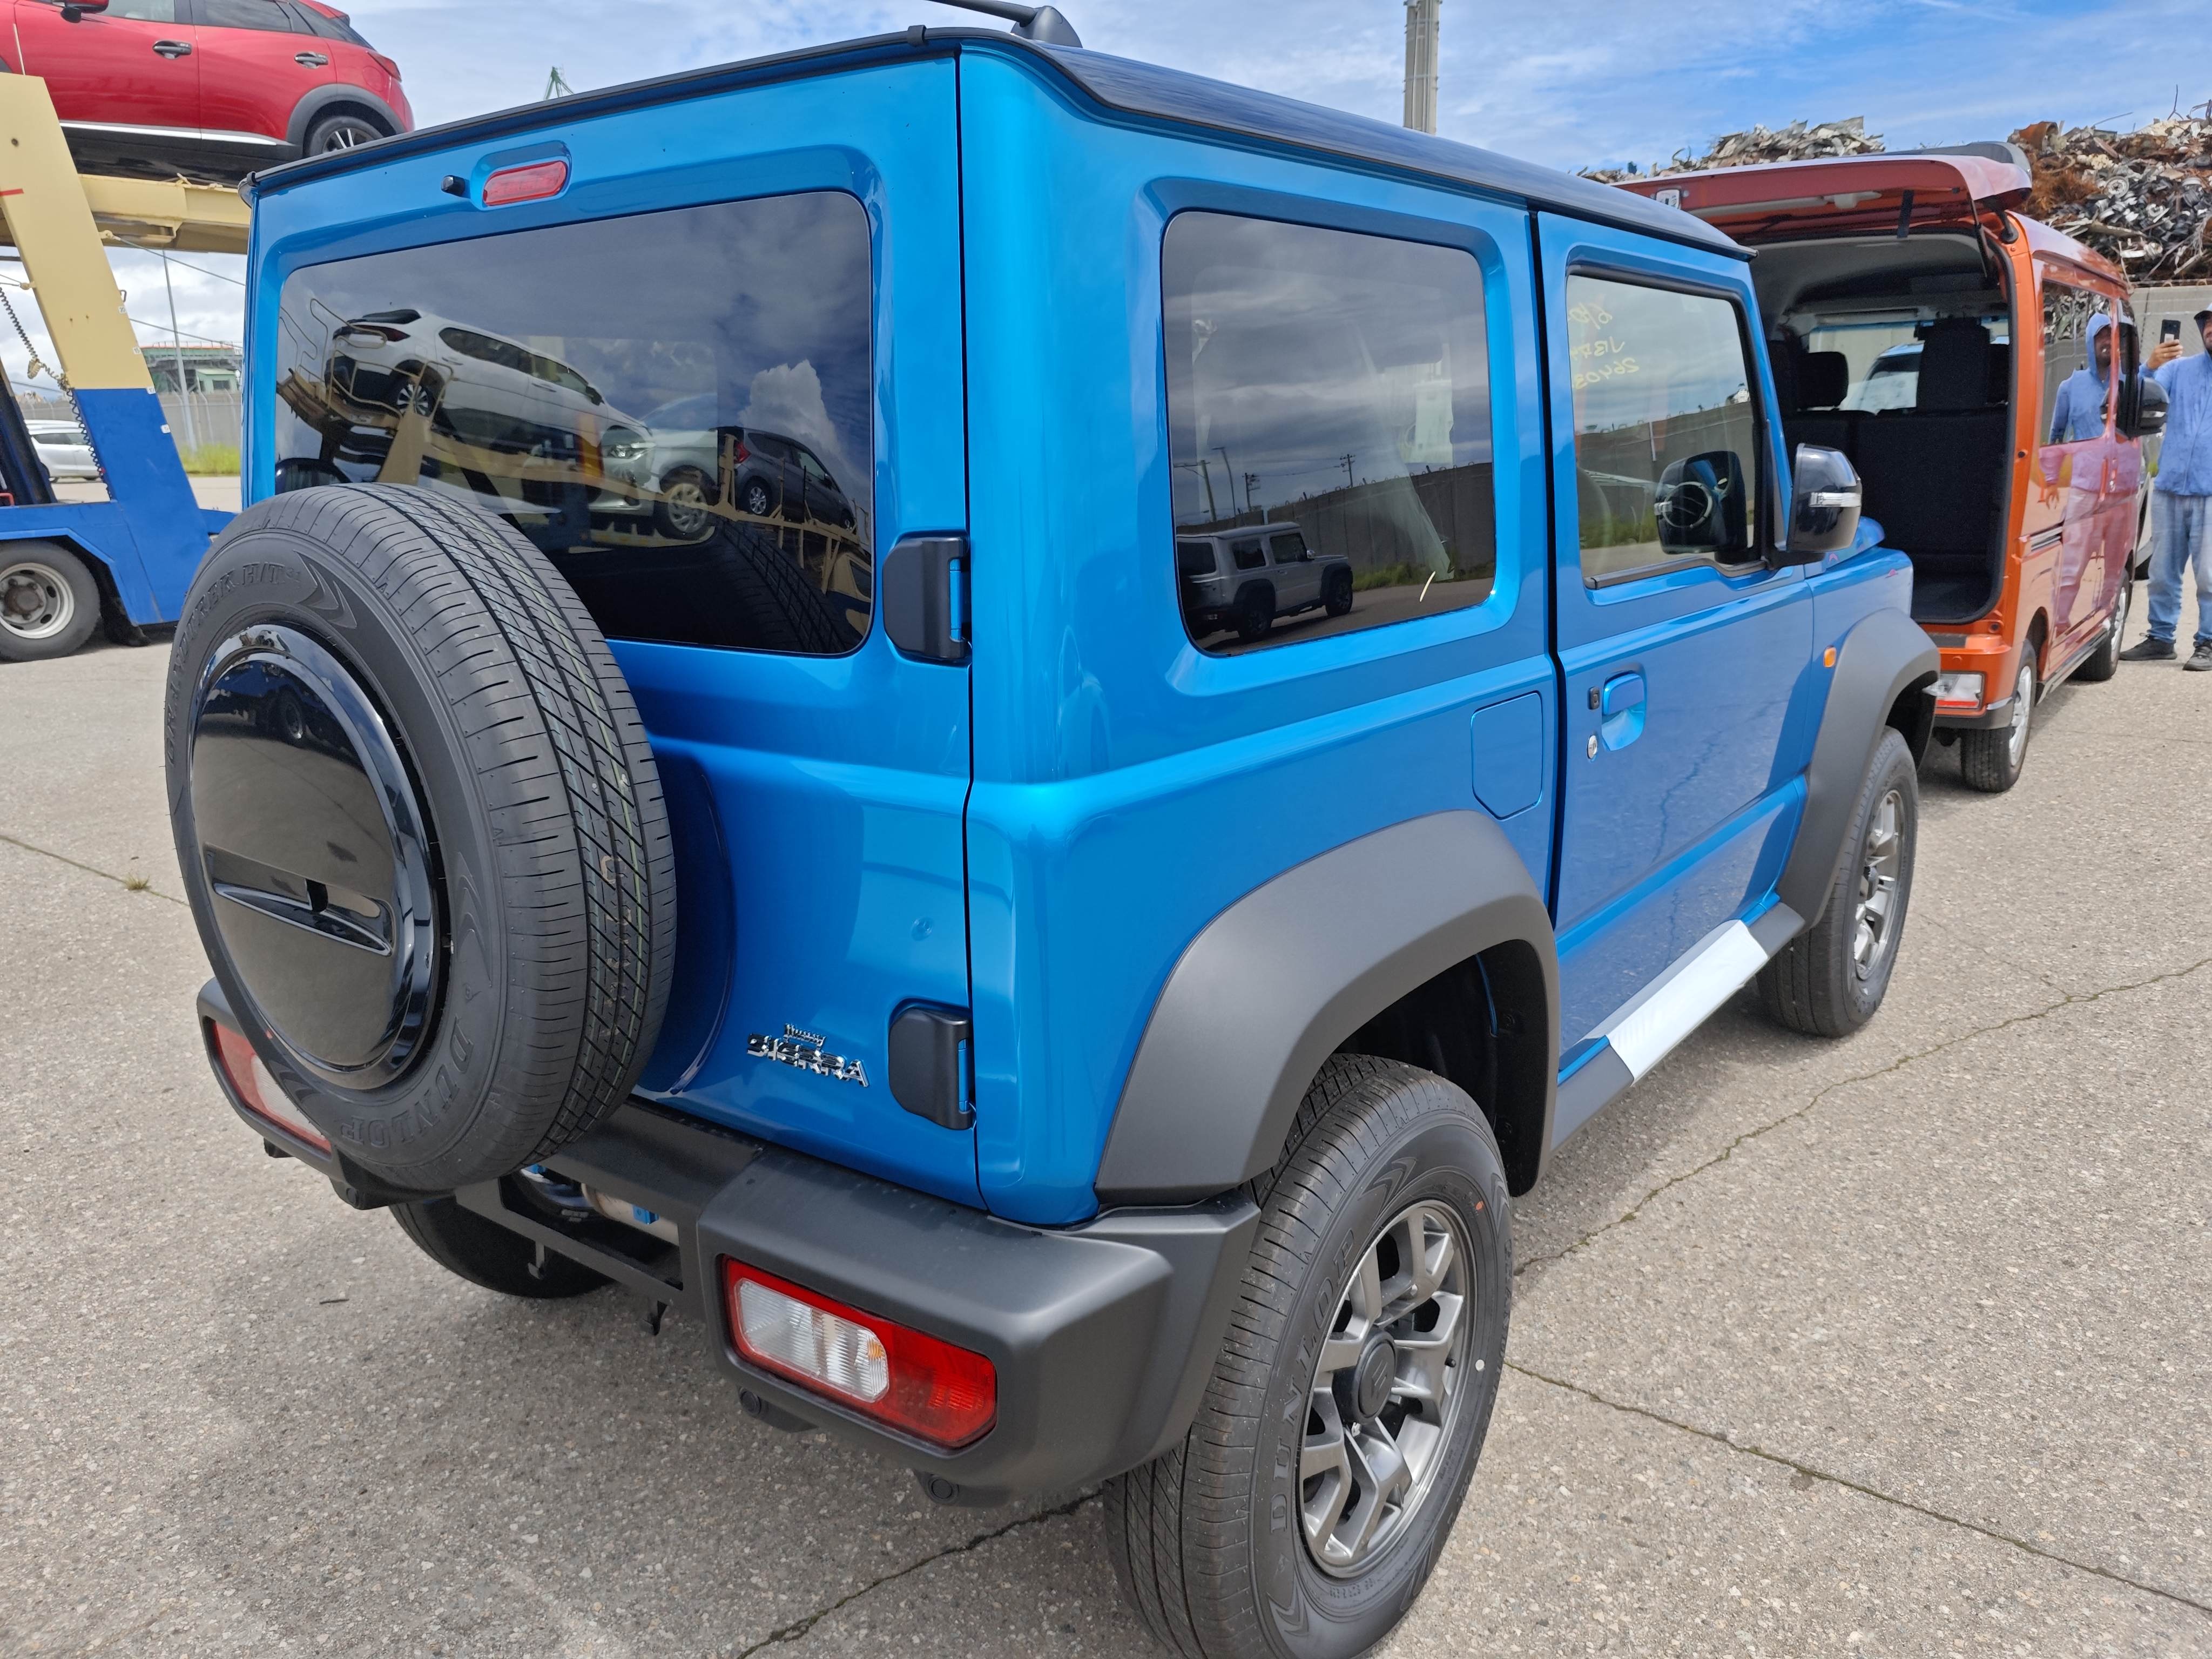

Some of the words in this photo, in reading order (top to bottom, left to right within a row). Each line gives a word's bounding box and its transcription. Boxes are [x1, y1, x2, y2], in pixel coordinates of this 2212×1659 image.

[340, 1013, 474, 1149] DUNLOP
[747, 1033, 871, 1088] SIERRA
[1270, 1228, 1354, 1534] DUNLOP
